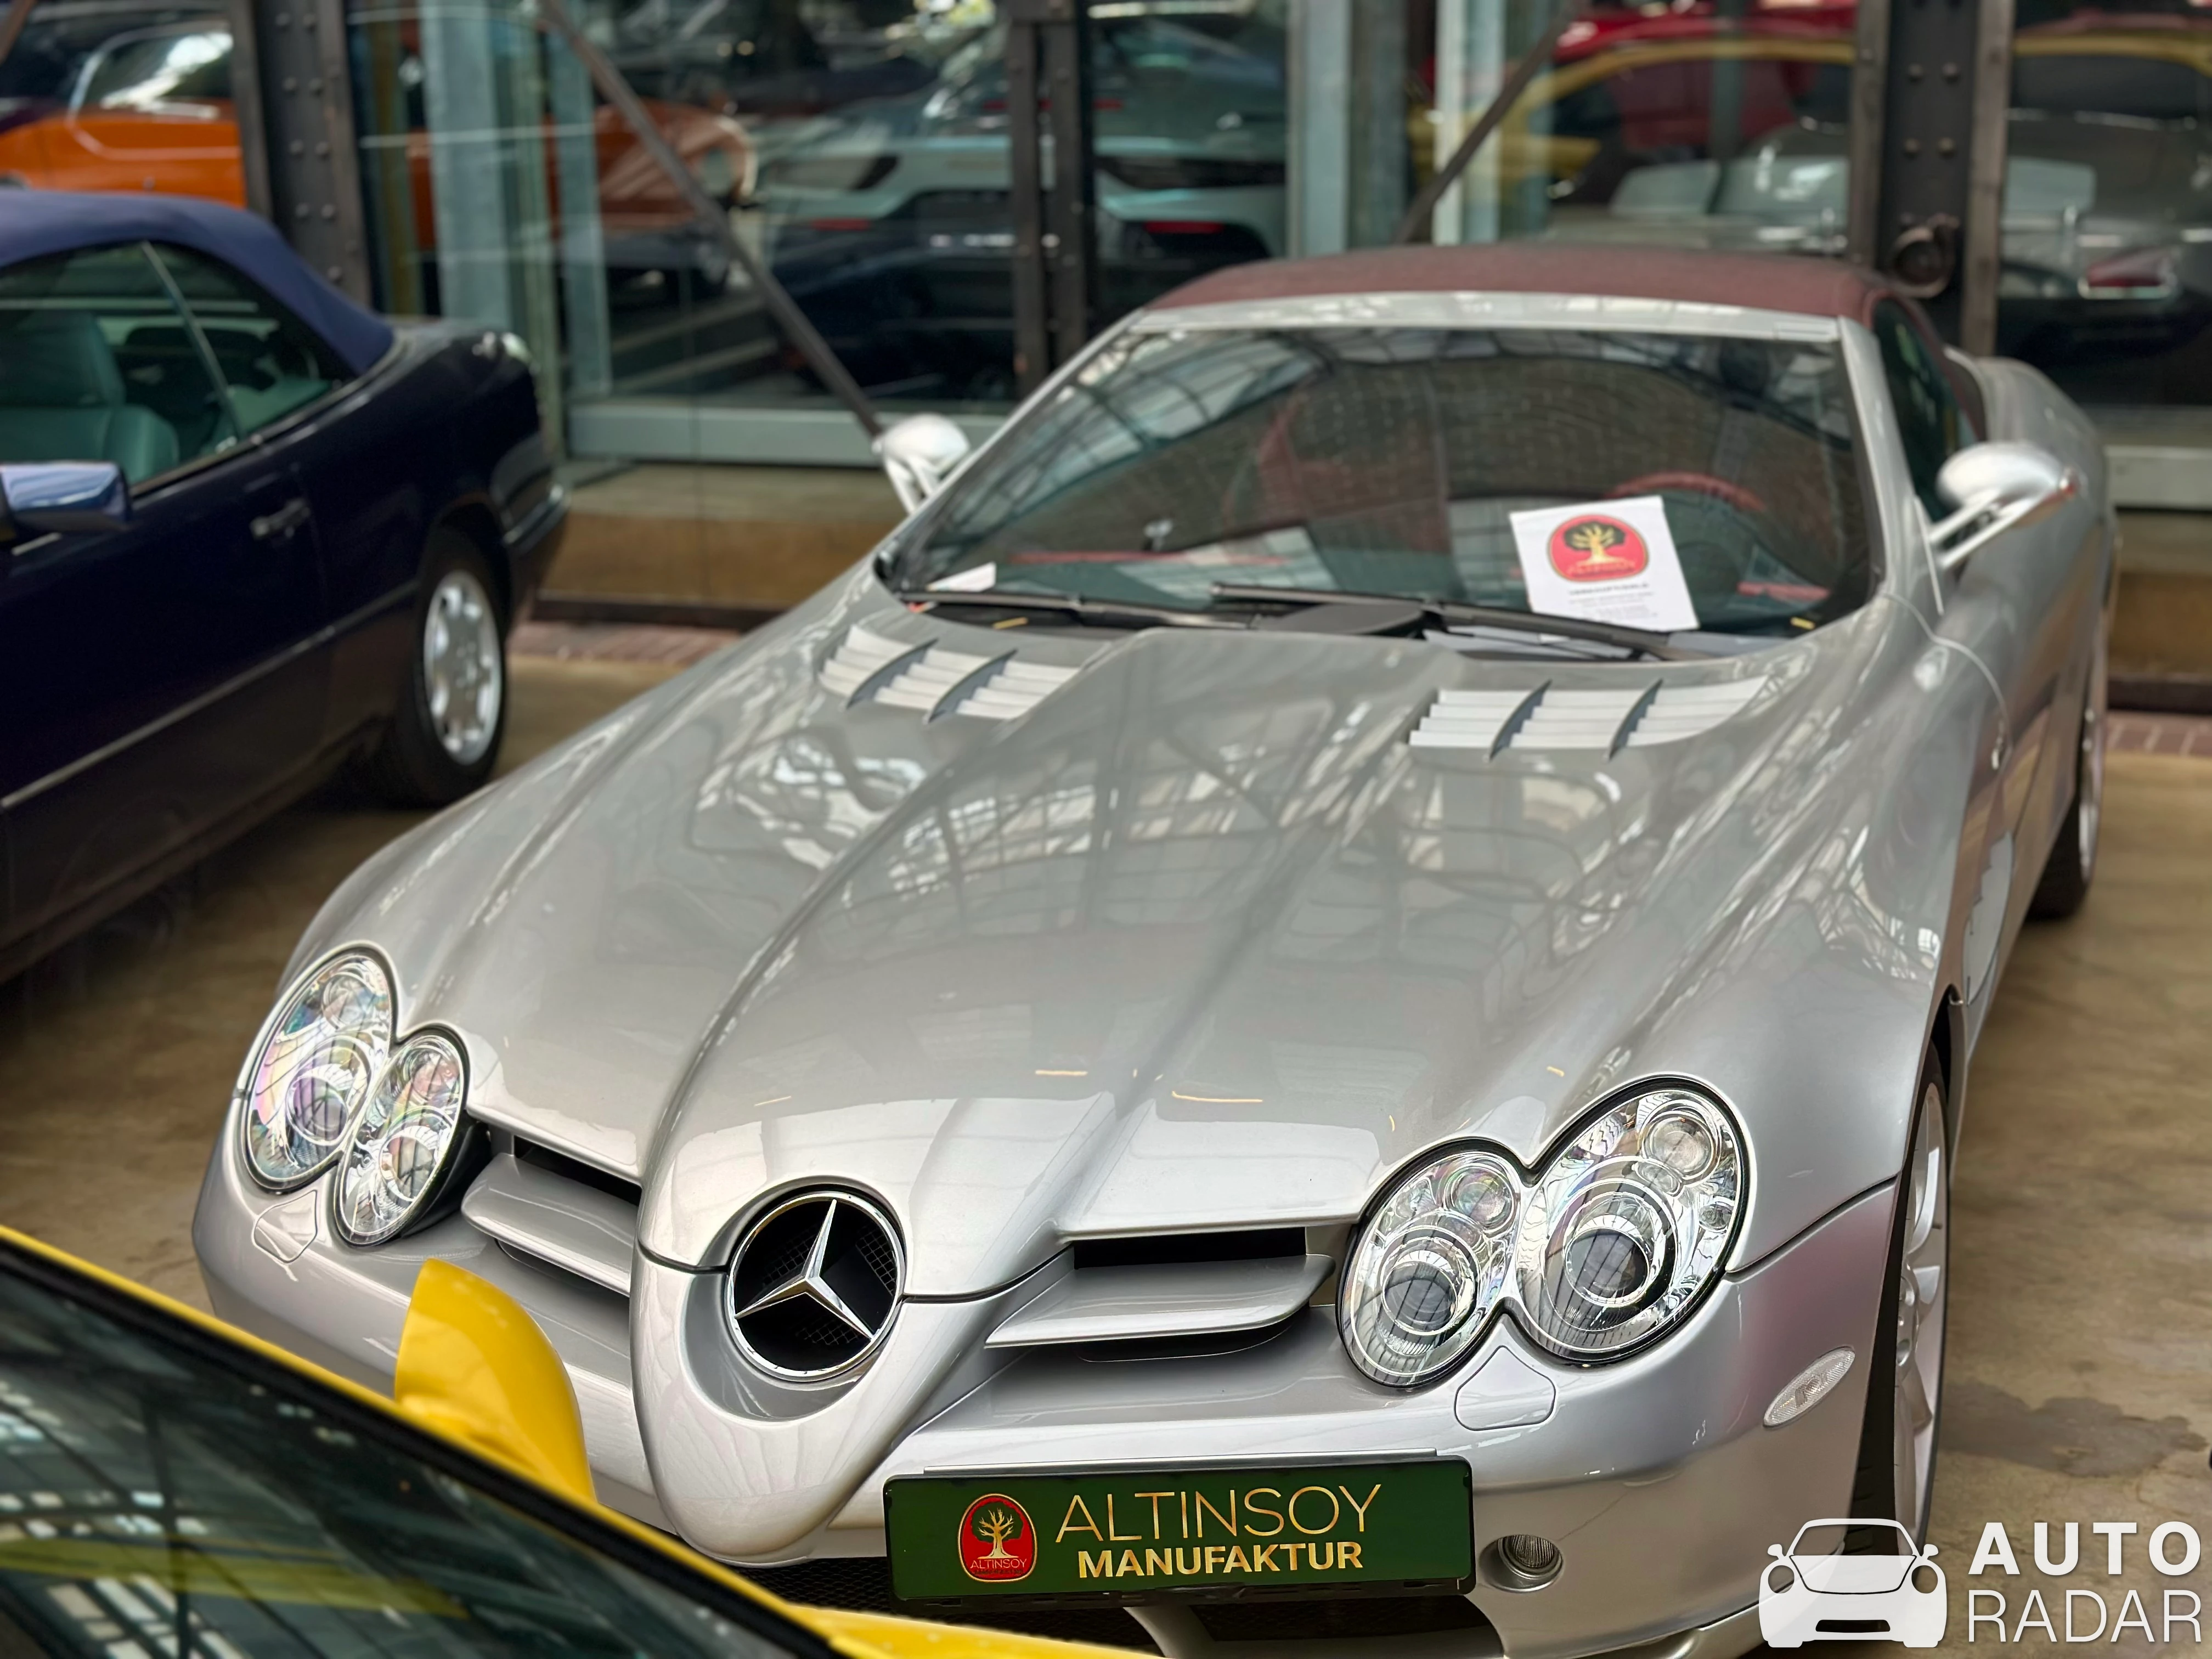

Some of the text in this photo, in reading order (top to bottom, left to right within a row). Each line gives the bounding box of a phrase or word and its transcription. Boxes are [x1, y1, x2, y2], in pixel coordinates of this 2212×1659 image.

[1056, 1483, 1381, 1543] ALTINSOY
[970, 1558, 1027, 1569] ALTINSOY
[1077, 1541, 1363, 1578] MANUFAKTUR
